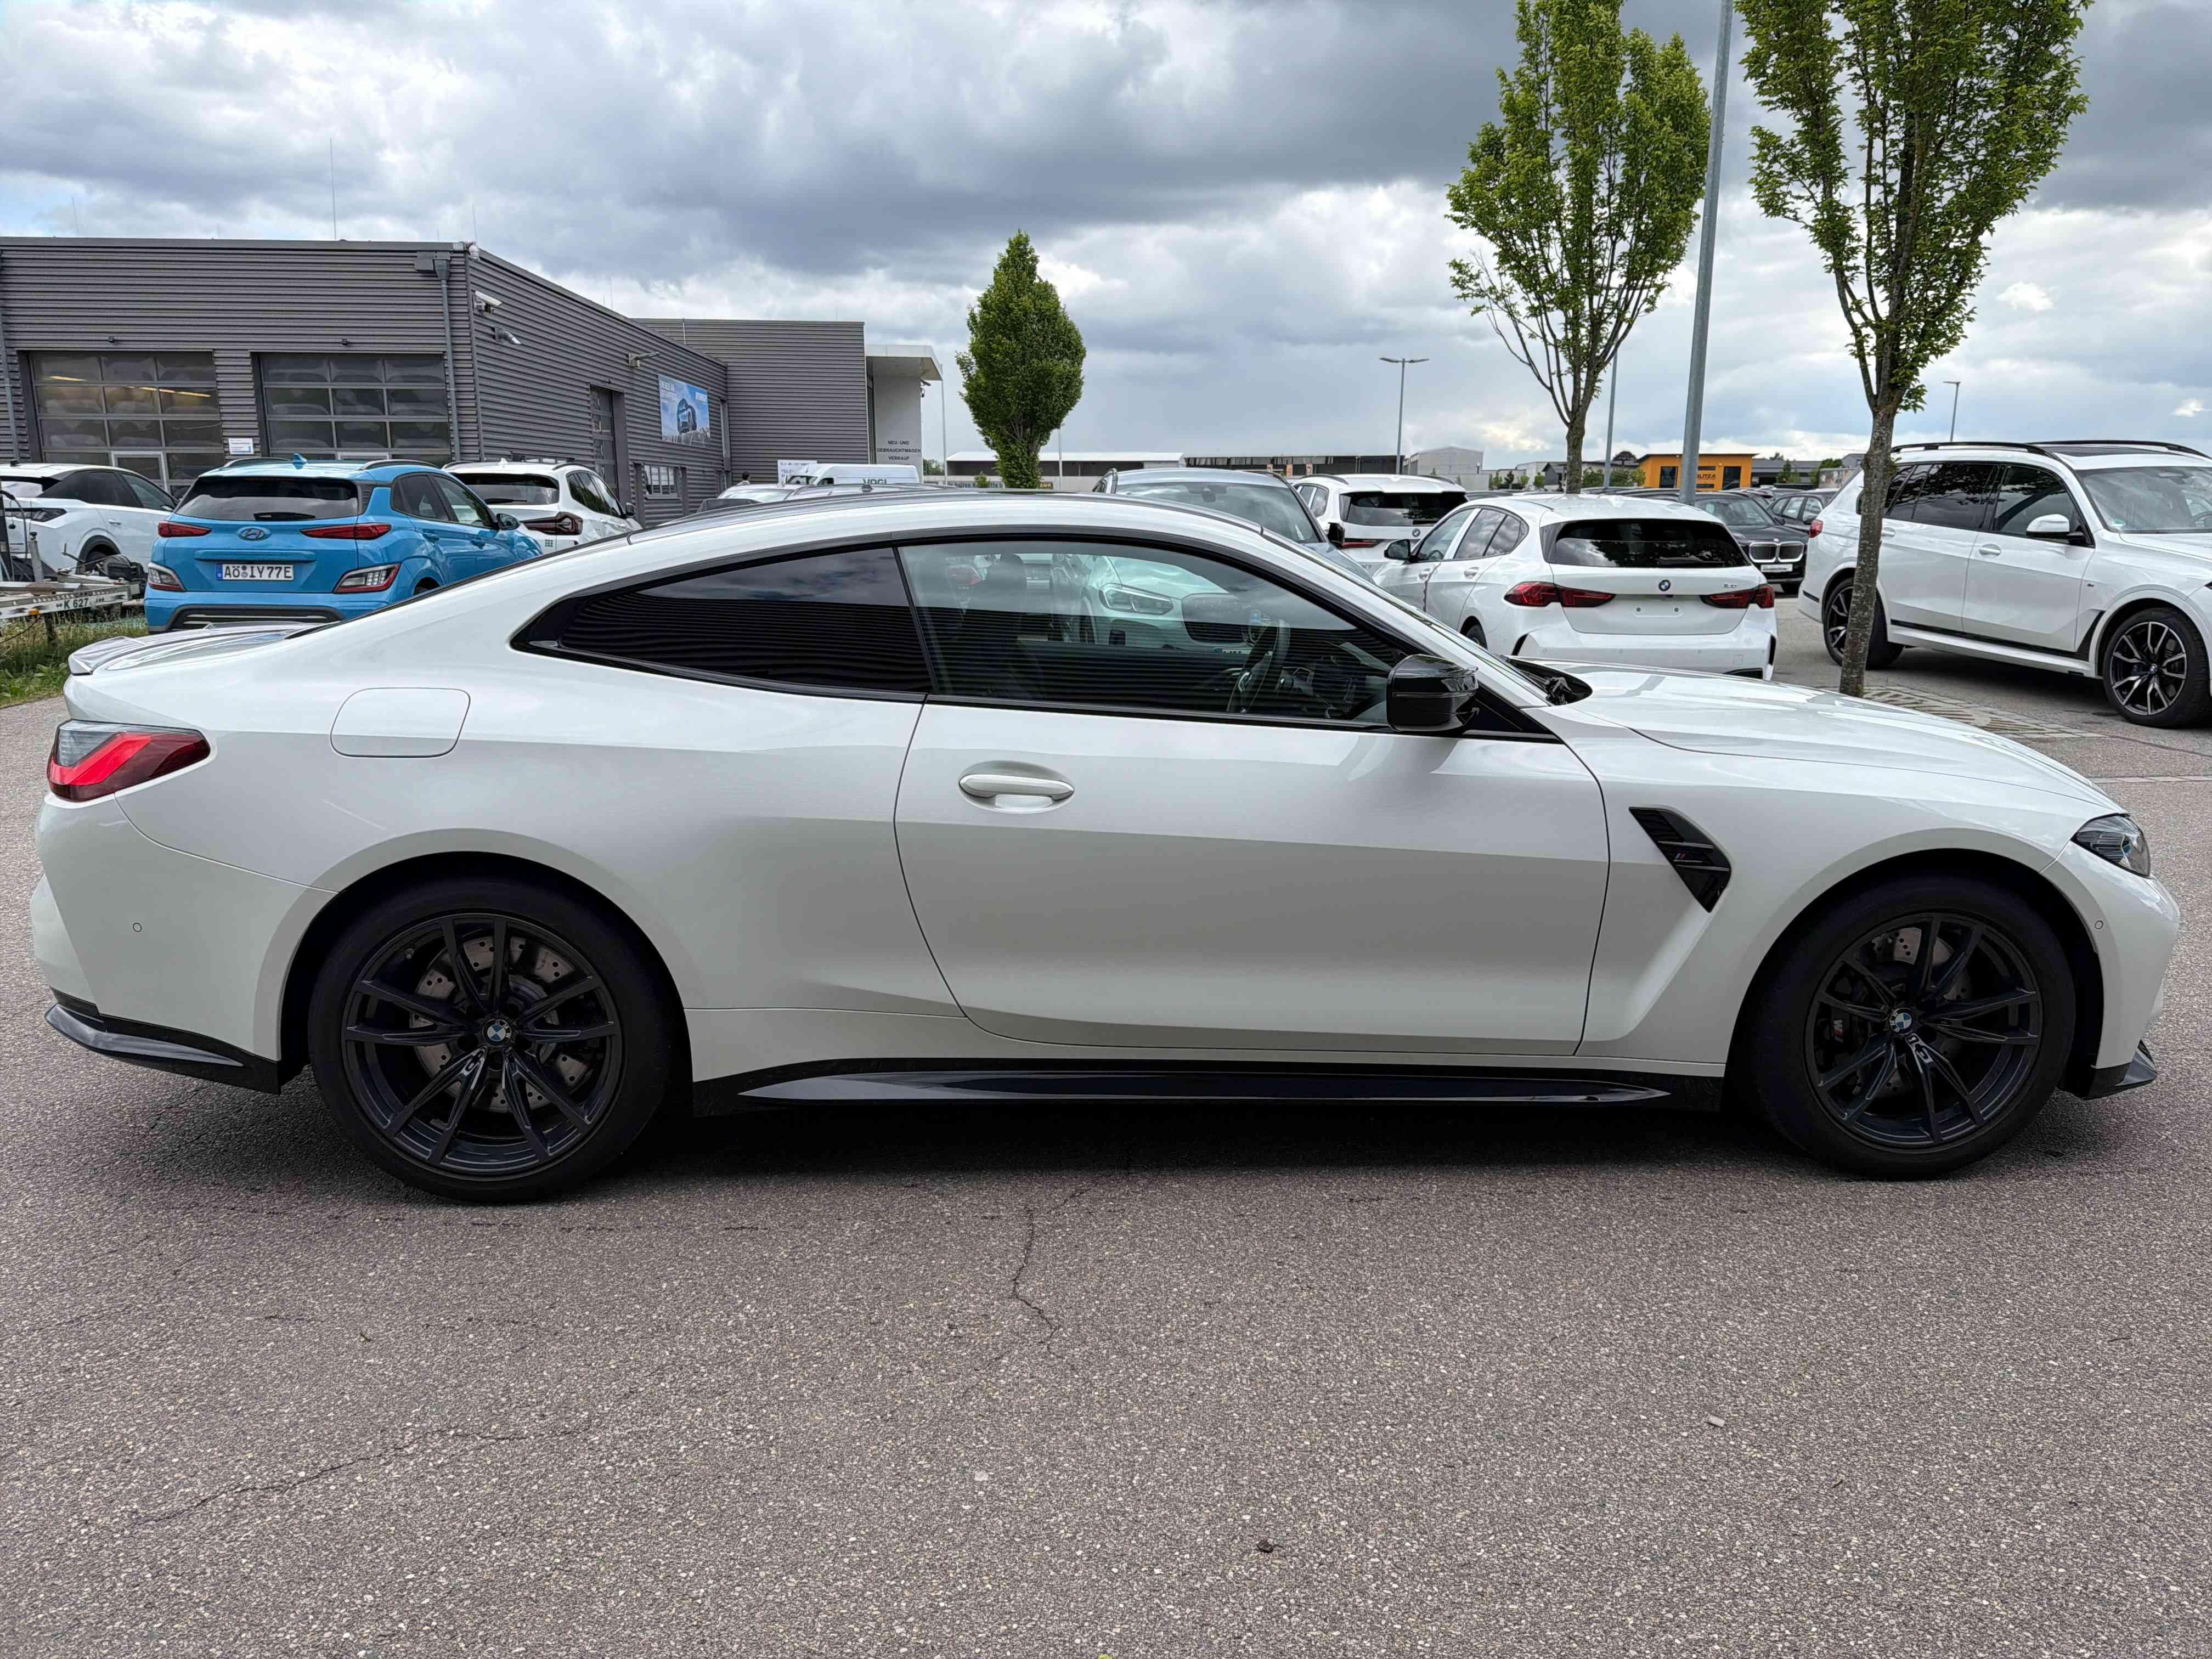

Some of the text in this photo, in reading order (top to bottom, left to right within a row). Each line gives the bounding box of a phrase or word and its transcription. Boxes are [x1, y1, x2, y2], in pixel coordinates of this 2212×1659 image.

[224, 566, 240, 578] AÖ
[64, 600, 70, 609] K
[73, 597, 89, 608] 627
